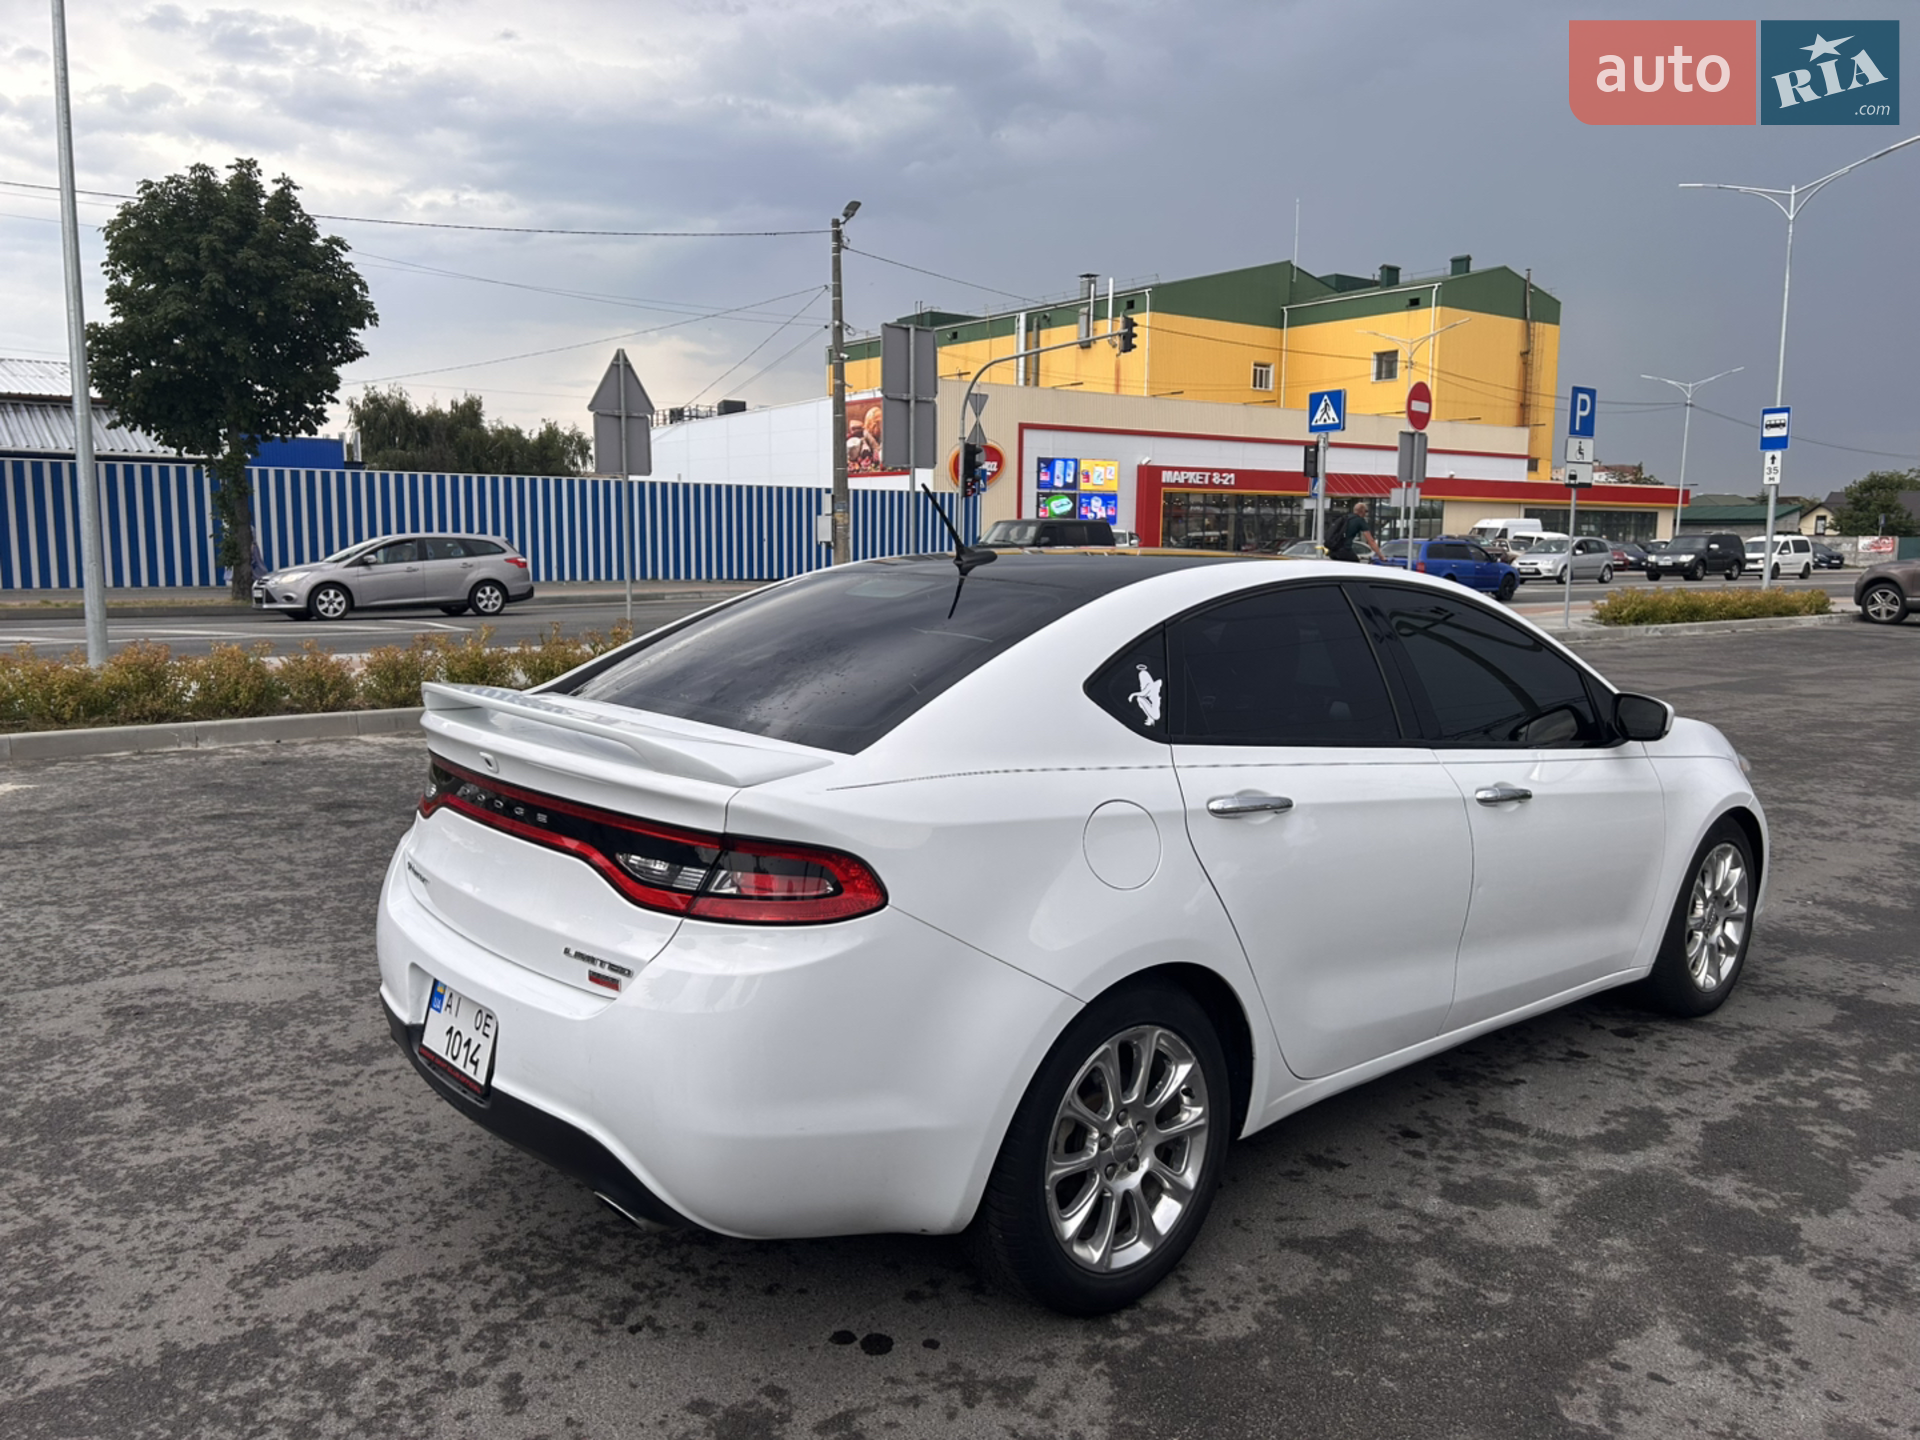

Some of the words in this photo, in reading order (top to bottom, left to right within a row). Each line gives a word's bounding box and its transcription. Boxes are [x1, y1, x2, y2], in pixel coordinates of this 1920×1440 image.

[1575, 393, 1592, 431] P
[1161, 470, 1211, 485] МАРКЕТ
[1212, 471, 1236, 486] 8-21
[1766, 466, 1780, 476] 35
[457, 785, 548, 824] DODGE
[444, 991, 462, 1018] AI
[445, 1025, 482, 1076] 1014
